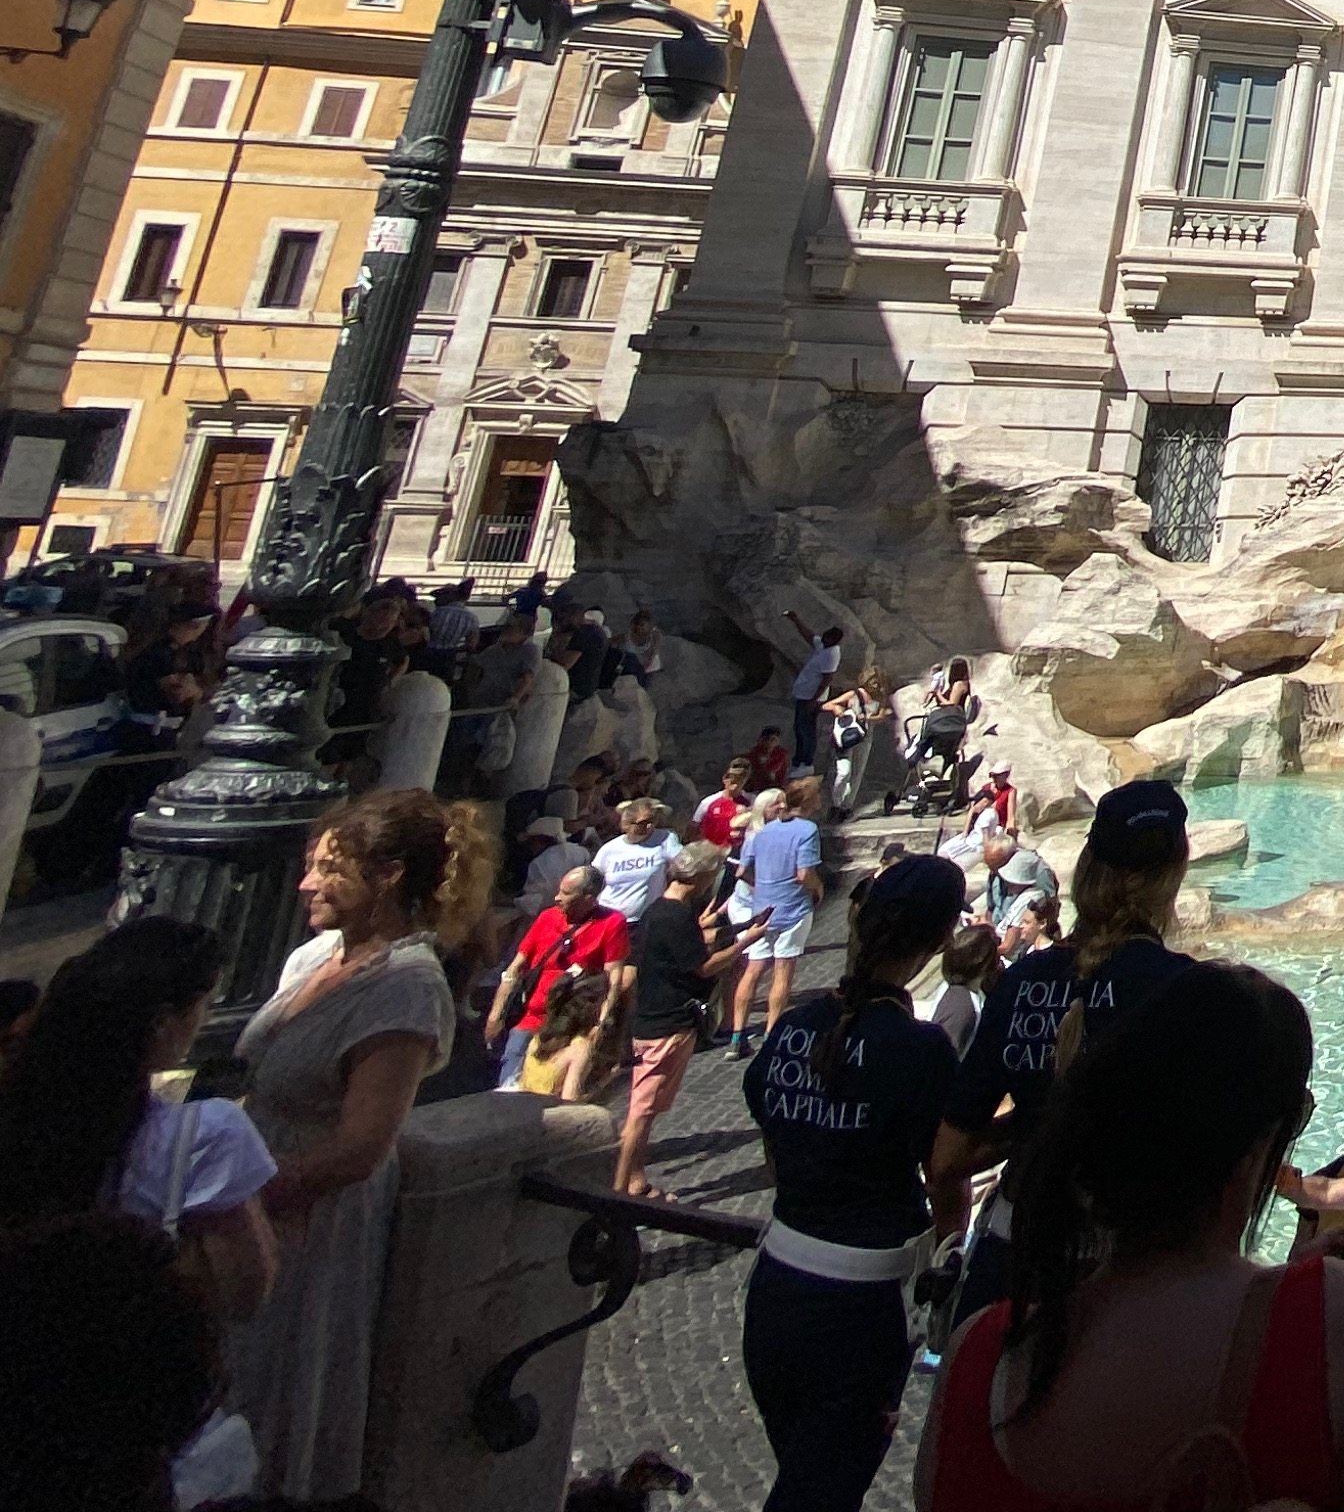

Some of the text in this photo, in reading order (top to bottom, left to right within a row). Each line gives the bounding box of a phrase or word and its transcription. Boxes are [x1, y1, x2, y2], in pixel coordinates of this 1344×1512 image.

[612, 855, 656, 873] MSCH
[1014, 980, 1115, 1008] POLIIA
[1008, 1011, 1058, 1039] ROM
[767, 1055, 826, 1092] ROM
[764, 1088, 871, 1129] CAPITALE
